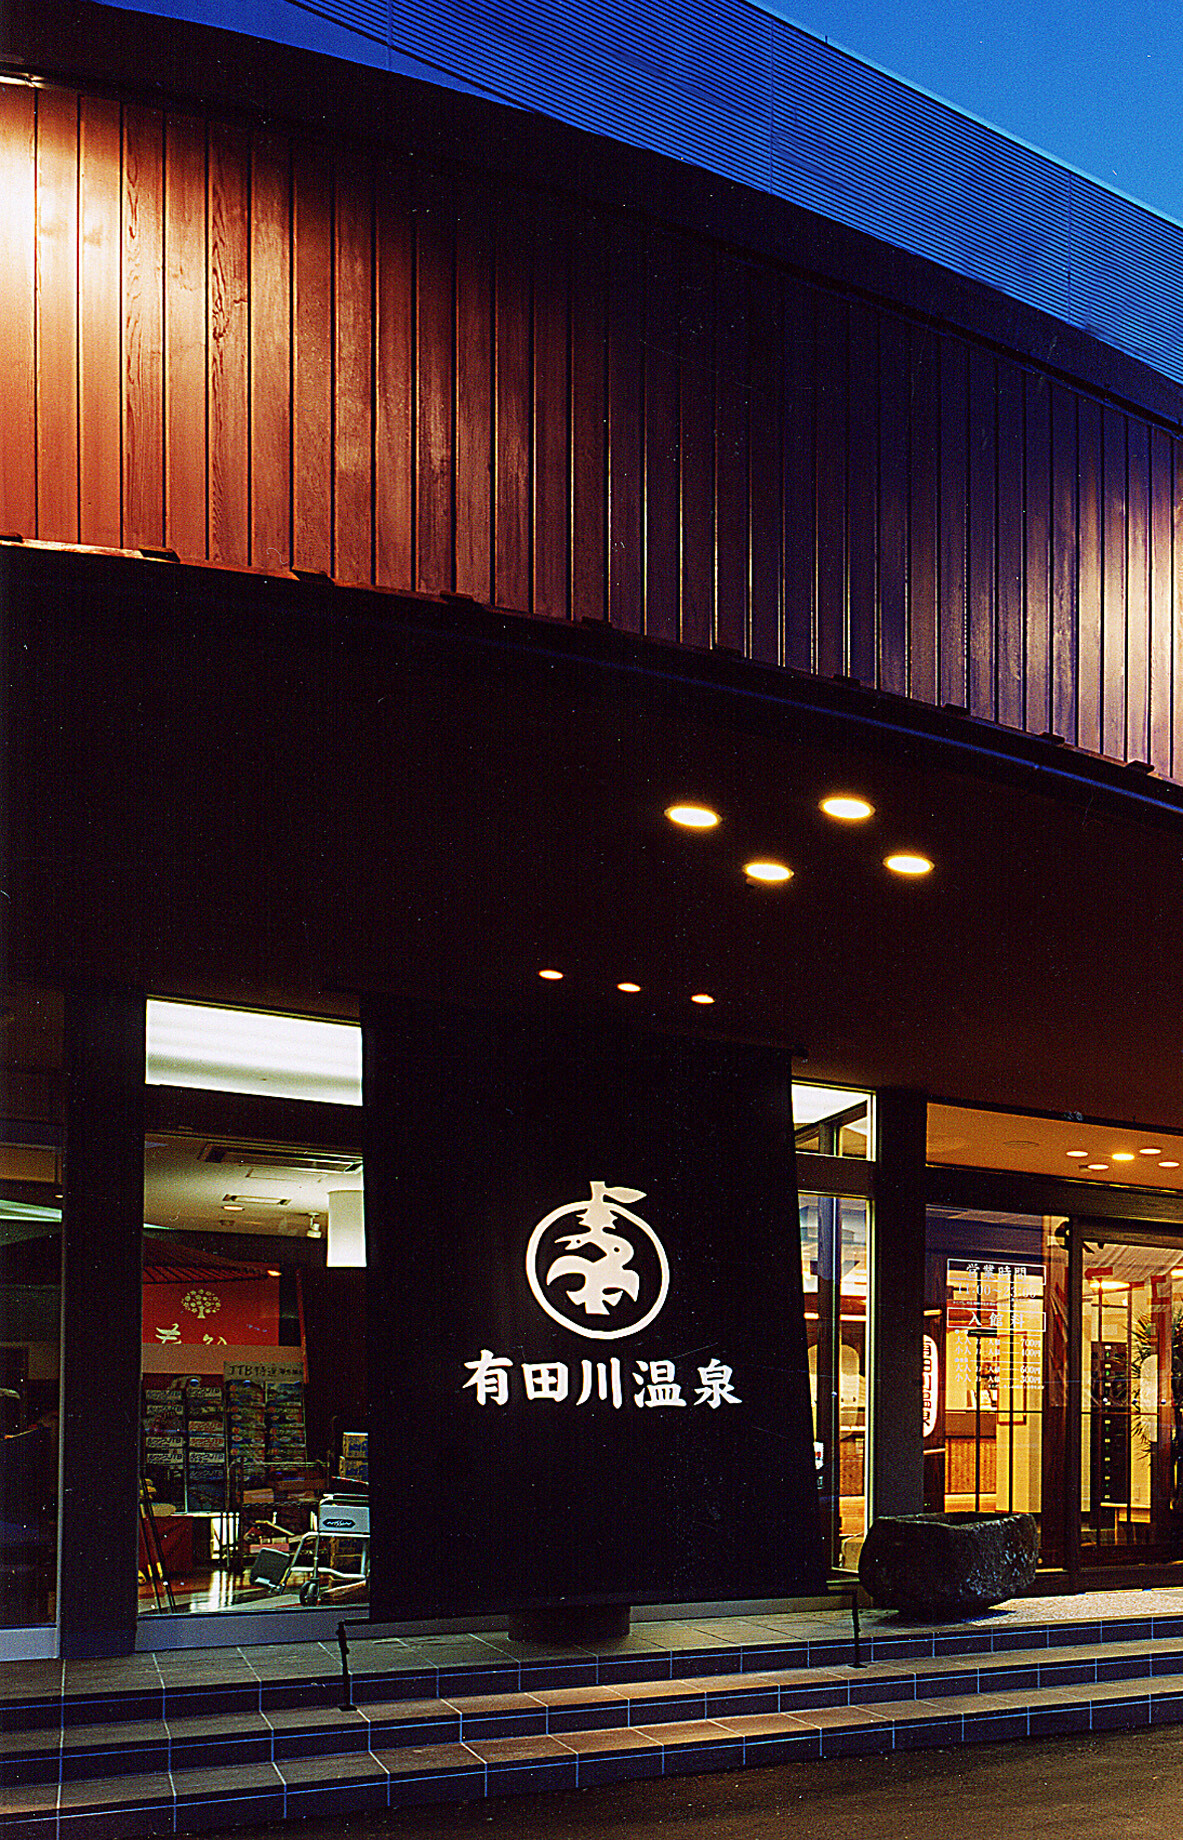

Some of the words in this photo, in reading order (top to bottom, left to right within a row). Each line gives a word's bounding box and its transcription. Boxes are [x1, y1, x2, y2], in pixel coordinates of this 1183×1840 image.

[966, 1263, 1027, 1281] 営業時間
[969, 1311, 1025, 1328] 入館料
[462, 1349, 742, 1409] 有田川温泉
